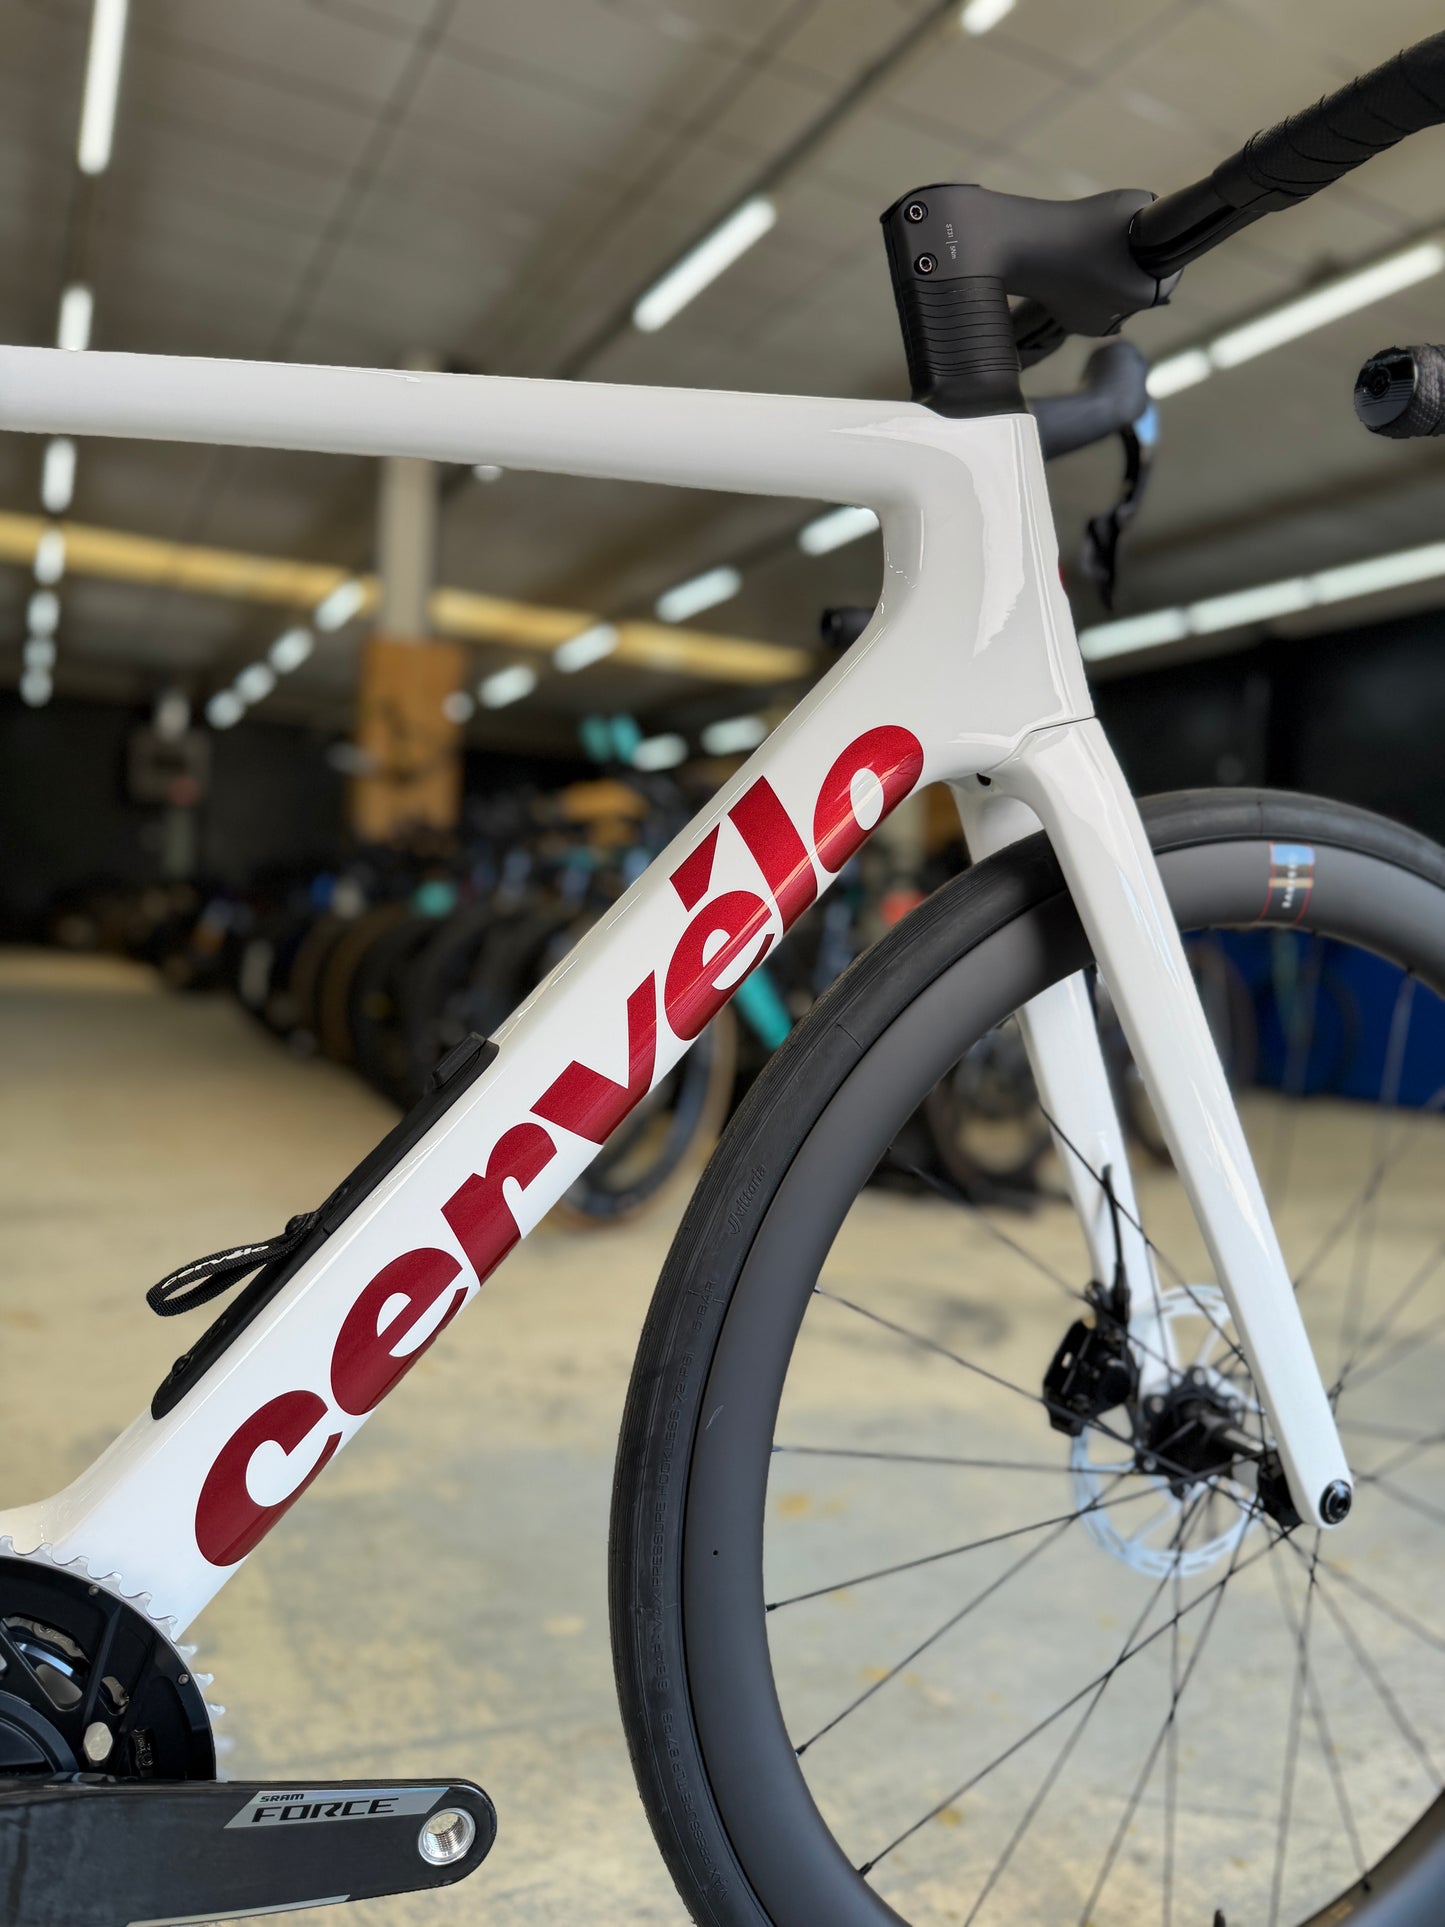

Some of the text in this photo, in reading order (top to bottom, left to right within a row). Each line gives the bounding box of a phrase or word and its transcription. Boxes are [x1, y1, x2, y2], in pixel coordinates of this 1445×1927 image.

[195, 725, 924, 1567] cervélo
[696, 1280, 717, 1317] BAR
[679, 1351, 696, 1378] PSI
[657, 1409, 681, 1496] HOOKLESS
[651, 1501, 667, 1588] PRESSURE
[251, 1797, 400, 1823] FORCE
[259, 1793, 305, 1802] SRAM
[680, 1791, 712, 1866] PRESSURE
